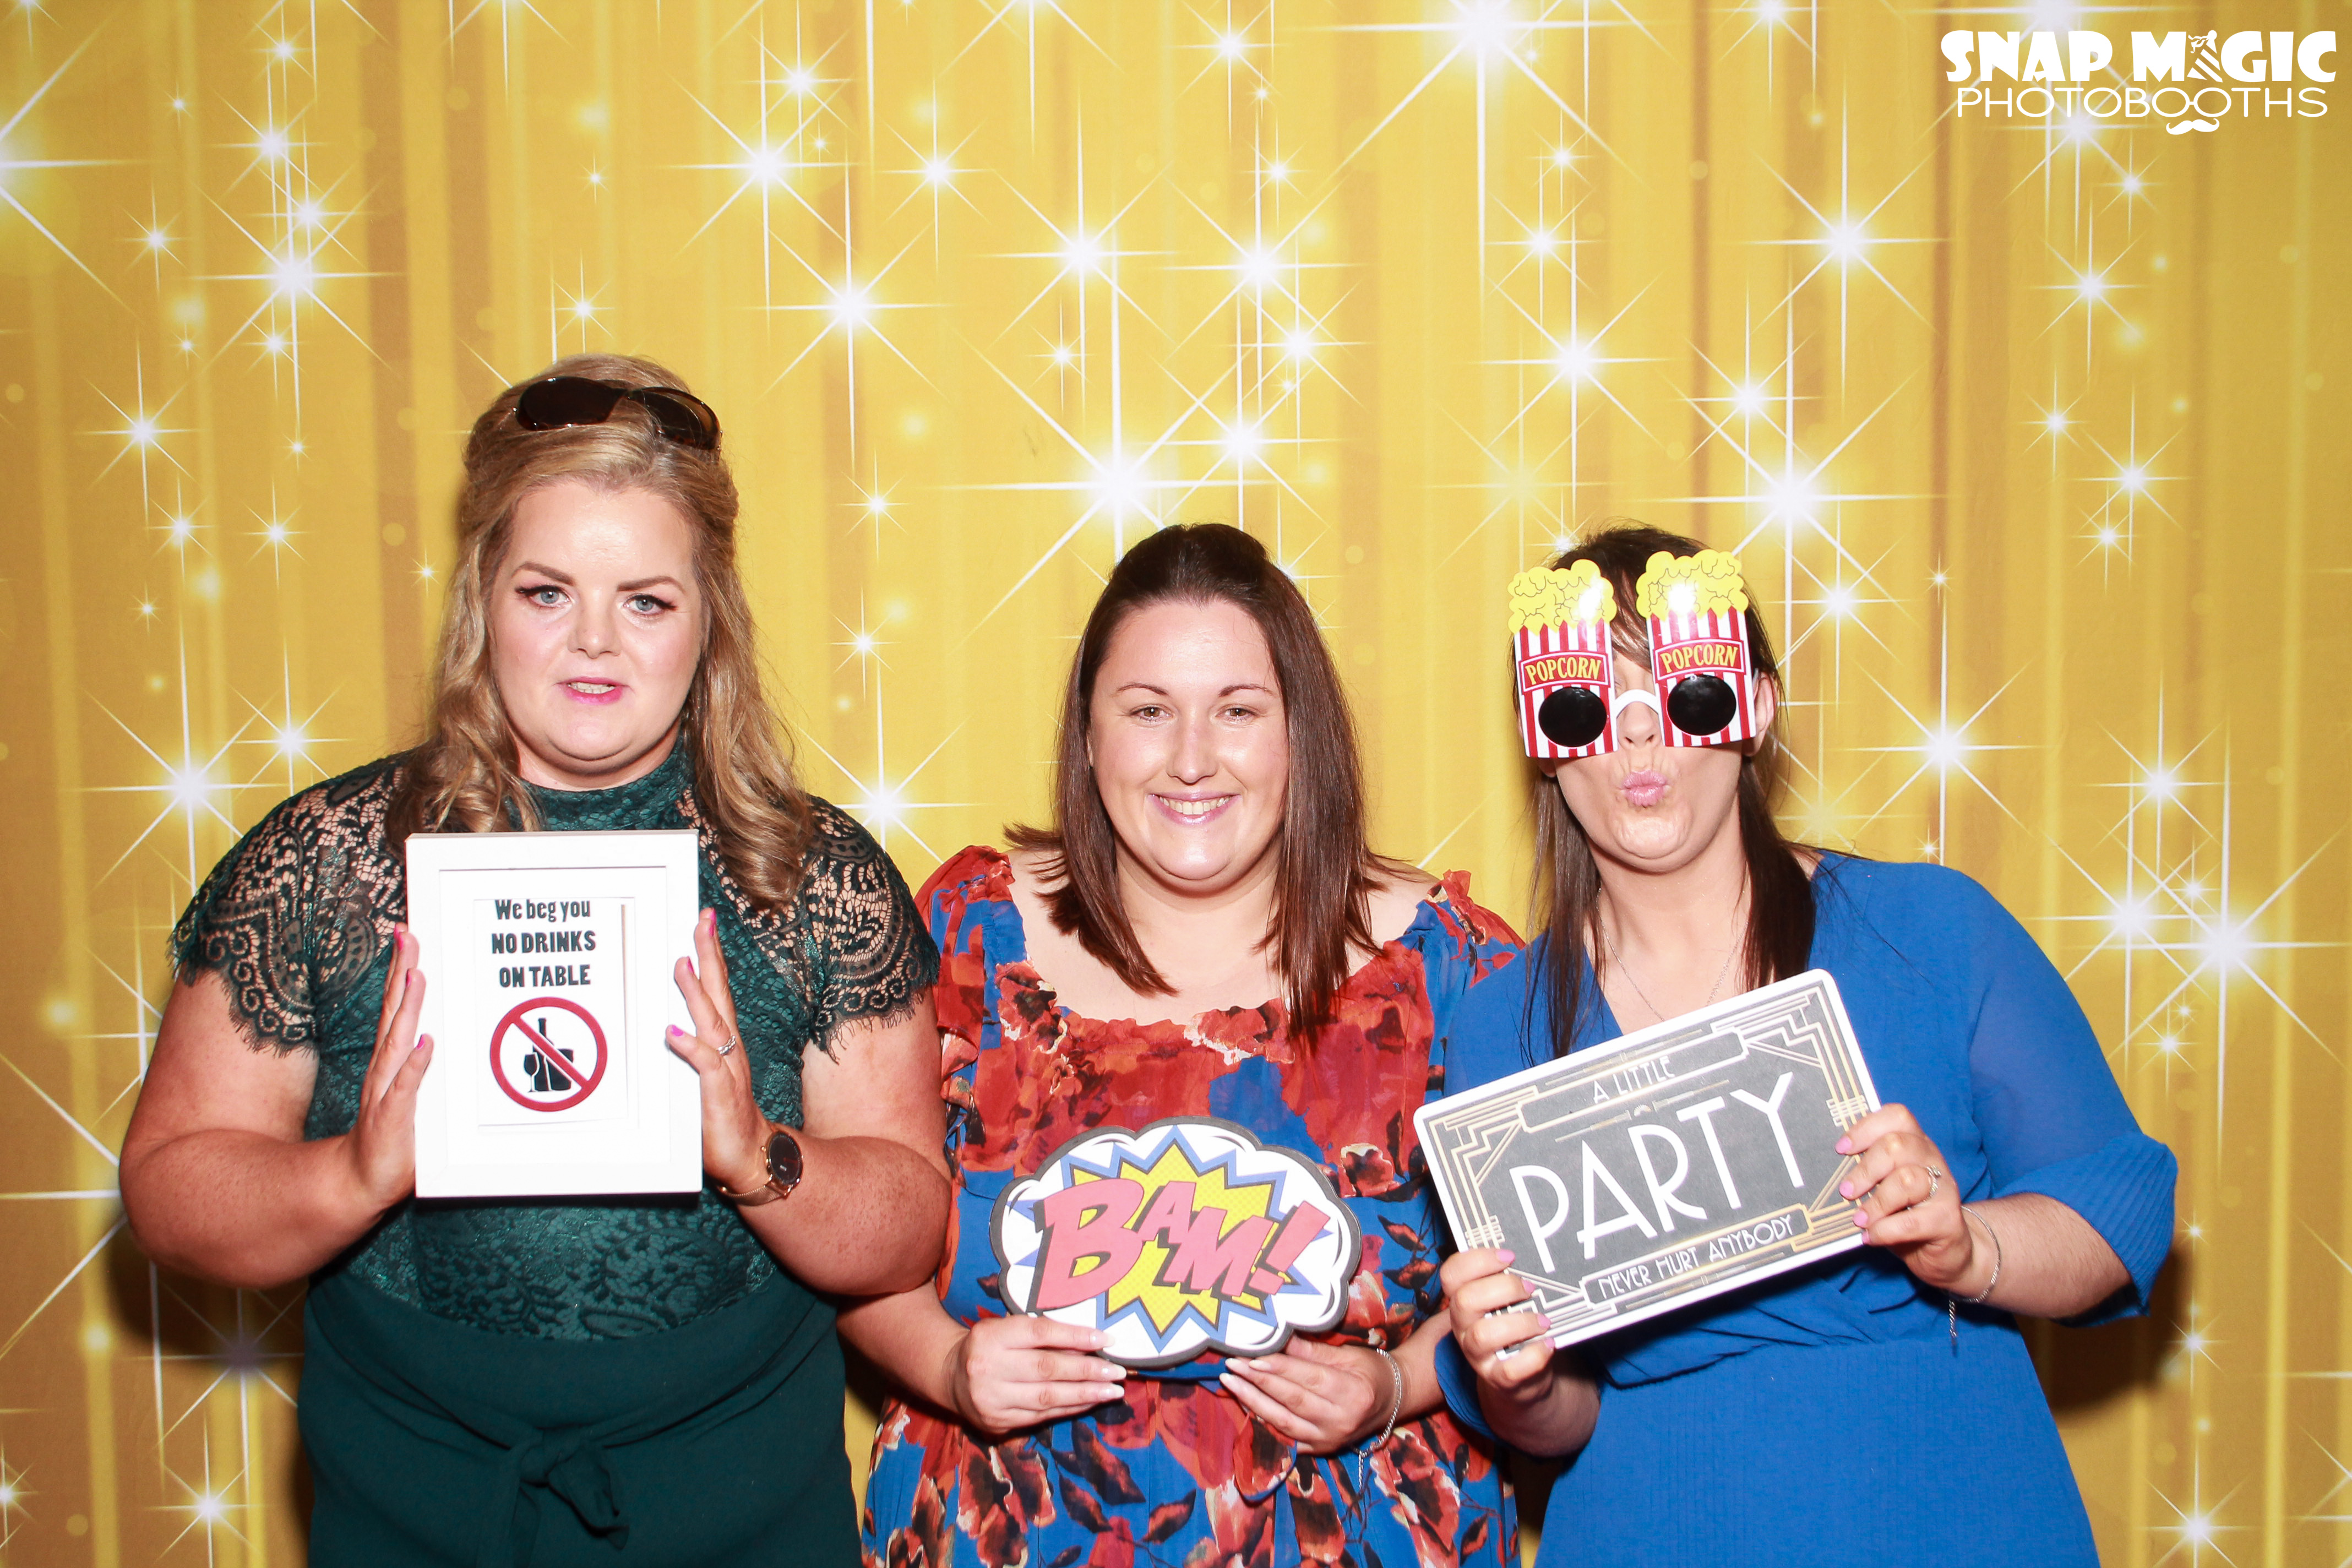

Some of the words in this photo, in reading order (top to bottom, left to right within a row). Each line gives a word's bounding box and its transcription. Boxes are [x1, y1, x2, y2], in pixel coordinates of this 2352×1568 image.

[1525, 657, 1601, 685] POPCORN
[1660, 644, 1738, 673] POPCORN
[494, 899, 522, 920] We
[526, 899, 556, 922] beg
[560, 900, 591, 922] you
[492, 933, 516, 954] NO
[521, 930, 596, 954] DRINKS
[499, 966, 525, 988] ON
[529, 965, 591, 987] TABLE
[1592, 1080, 1610, 1103] A
[1614, 1055, 1675, 1096] LITTLE
[1509, 1071, 1804, 1273] PARTY
[1033, 1177, 1331, 1309] BAM!
[1598, 1264, 1652, 1299] NEVER
[1656, 1246, 1699, 1278] HURT
[1708, 1215, 1793, 1261] ANYBODY
